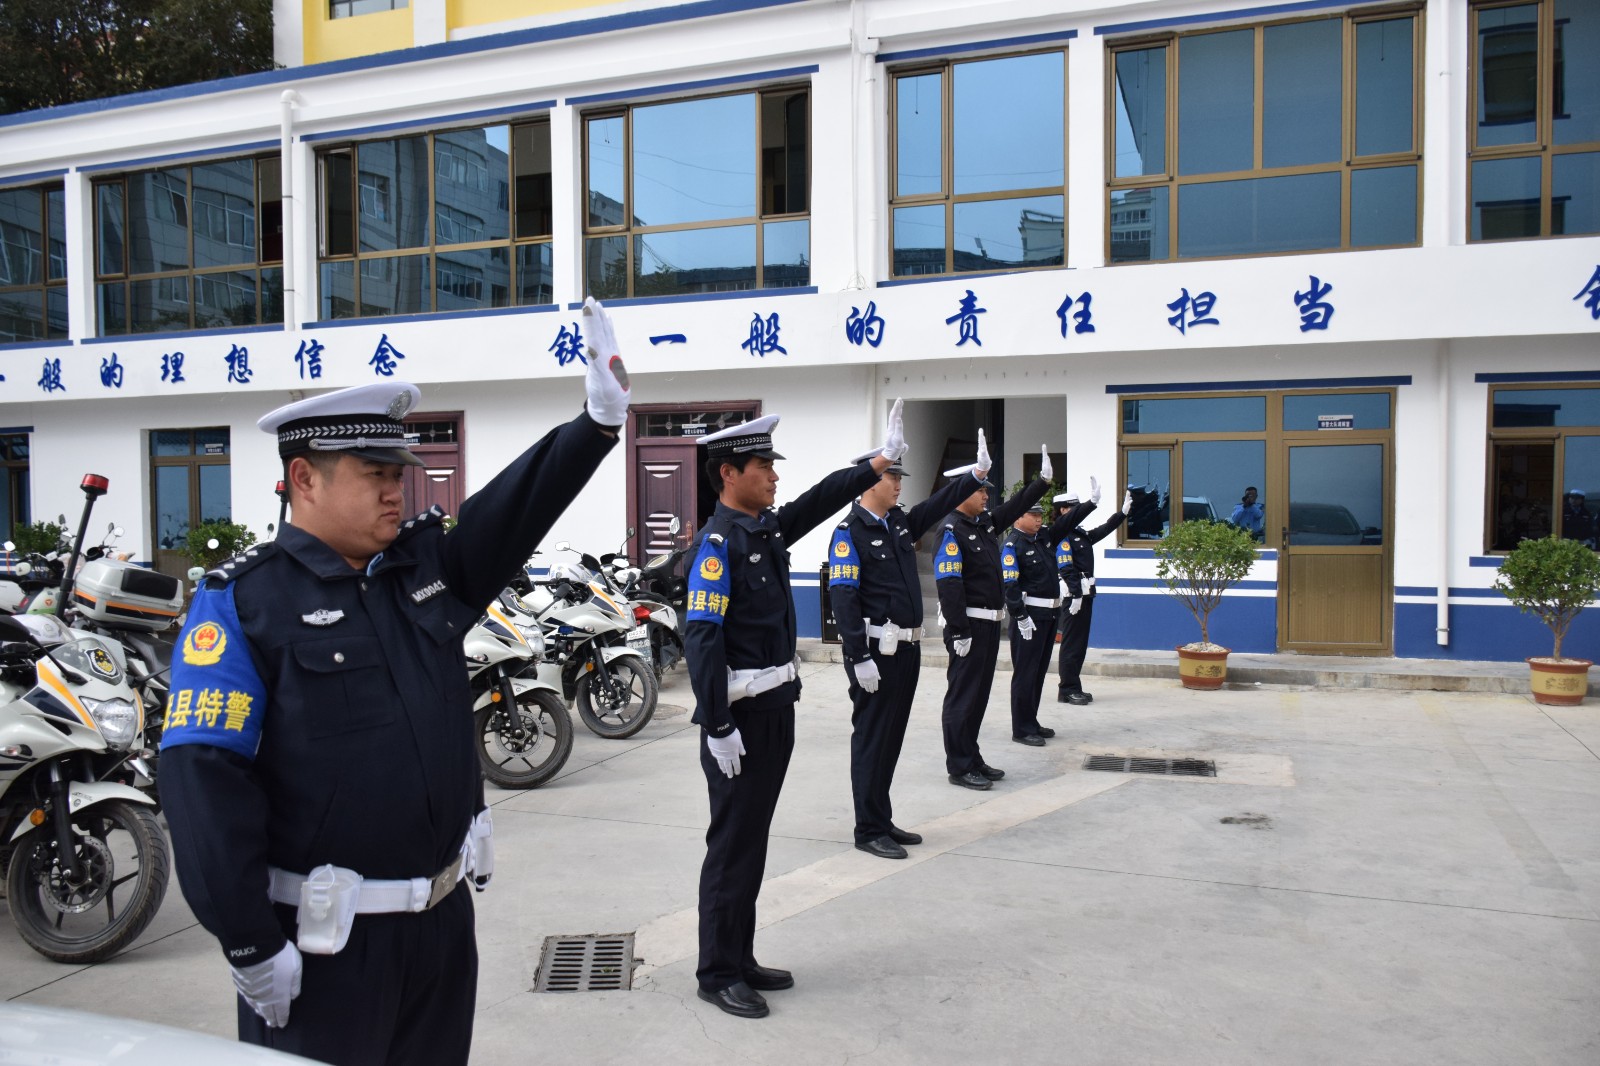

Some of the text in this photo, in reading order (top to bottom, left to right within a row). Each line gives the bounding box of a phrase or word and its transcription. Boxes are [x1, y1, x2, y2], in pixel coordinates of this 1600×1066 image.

[548, 275, 1335, 366] 铁一般的责任担当
[0, 335, 404, 393] 般的理想信念
[411, 579, 446, 602] MX0041
[230, 945, 257, 958] POLICE
